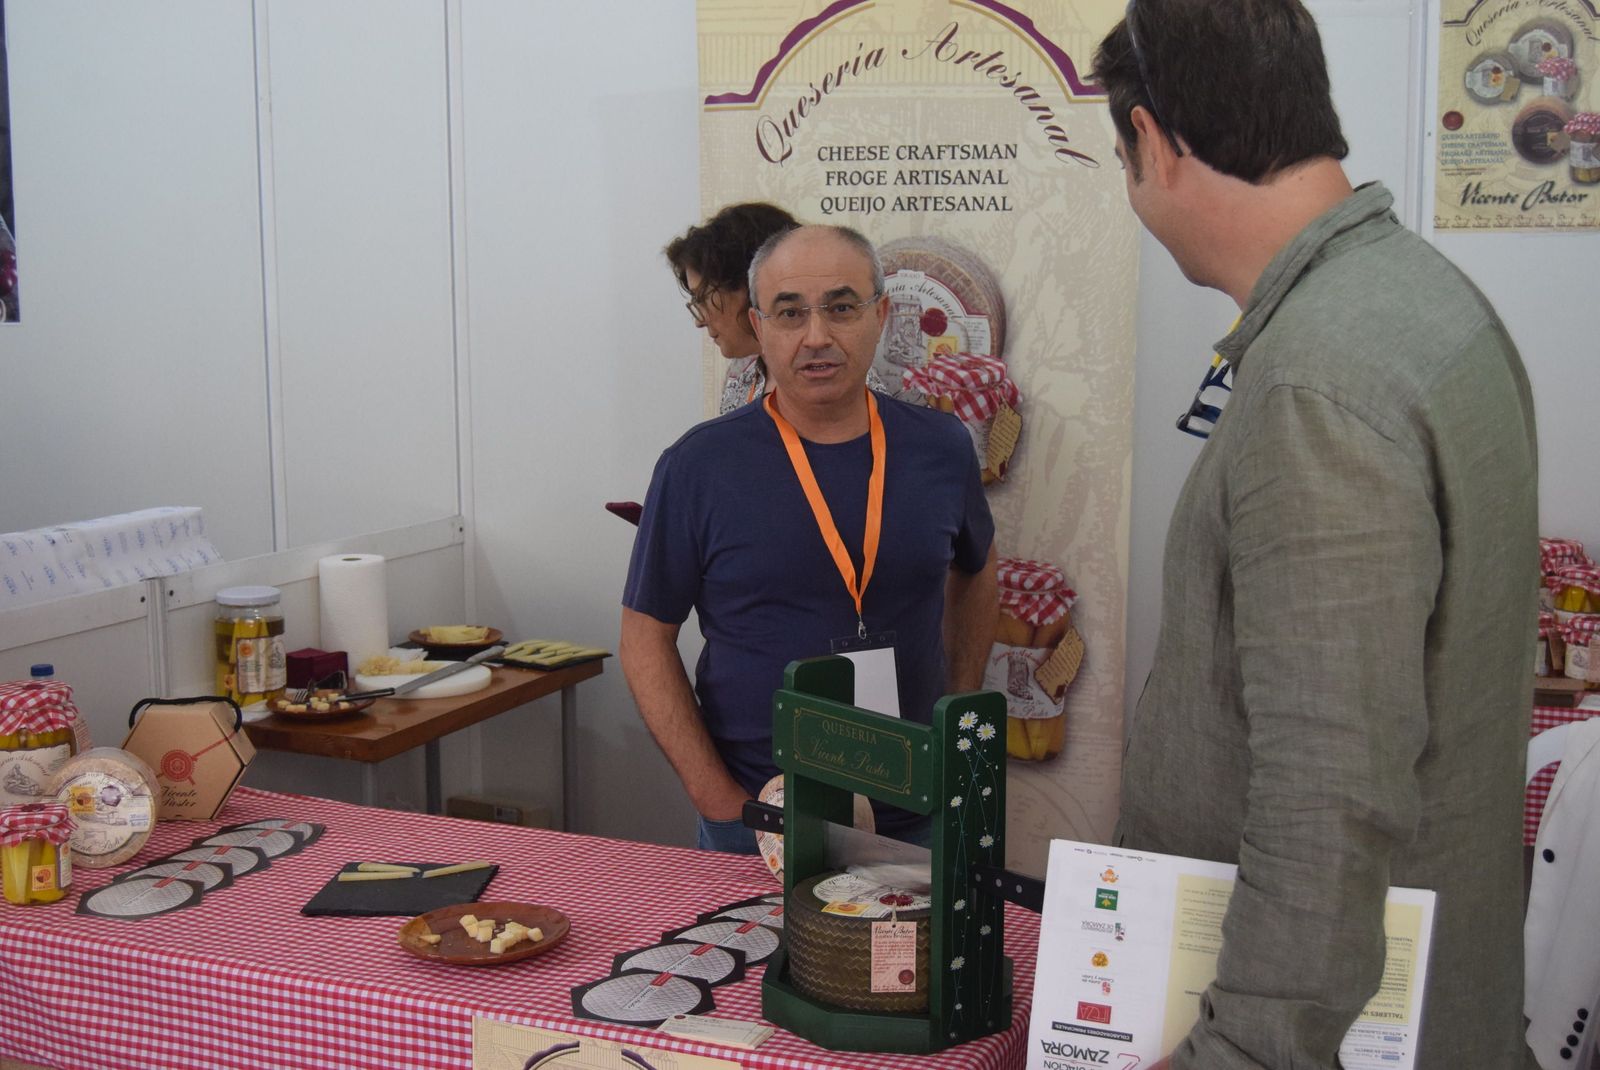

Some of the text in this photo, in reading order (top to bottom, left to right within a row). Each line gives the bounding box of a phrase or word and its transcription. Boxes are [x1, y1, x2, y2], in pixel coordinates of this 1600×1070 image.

[901, 21, 1101, 169] Artesanal
[817, 143, 1018, 163] CHEESE CRAFTSMAN
[825, 168, 1009, 187] FROGE ARTISANAL
[820, 195, 1013, 215] QUEIJO ARTESANAL
[1460, 181, 1519, 207] Vicente
[822, 719, 878, 745] QUESERIA
[809, 735, 891, 779] Vicente Pastor
[1372, 1010, 1404, 1019] TALLERES
[1041, 1039, 1110, 1064] ZAMORA
